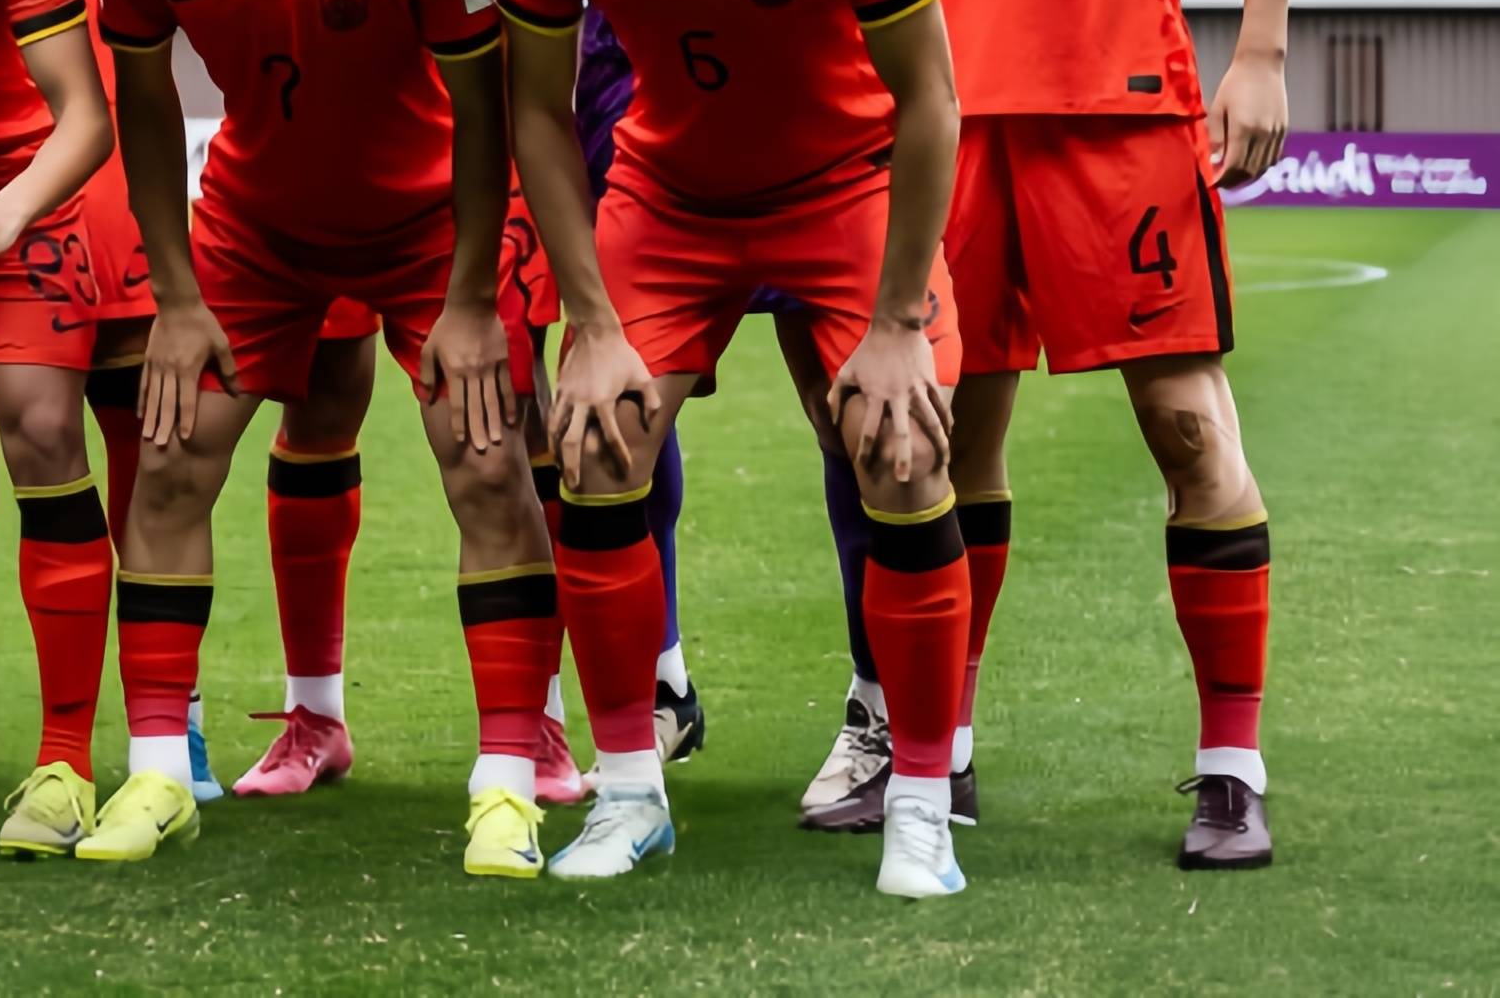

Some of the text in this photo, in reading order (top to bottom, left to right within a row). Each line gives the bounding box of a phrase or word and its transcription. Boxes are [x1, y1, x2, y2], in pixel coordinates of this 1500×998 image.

[261, 55, 300, 122] 7
[679, 30, 729, 91] 6
[1129, 206, 1177, 289] 4
